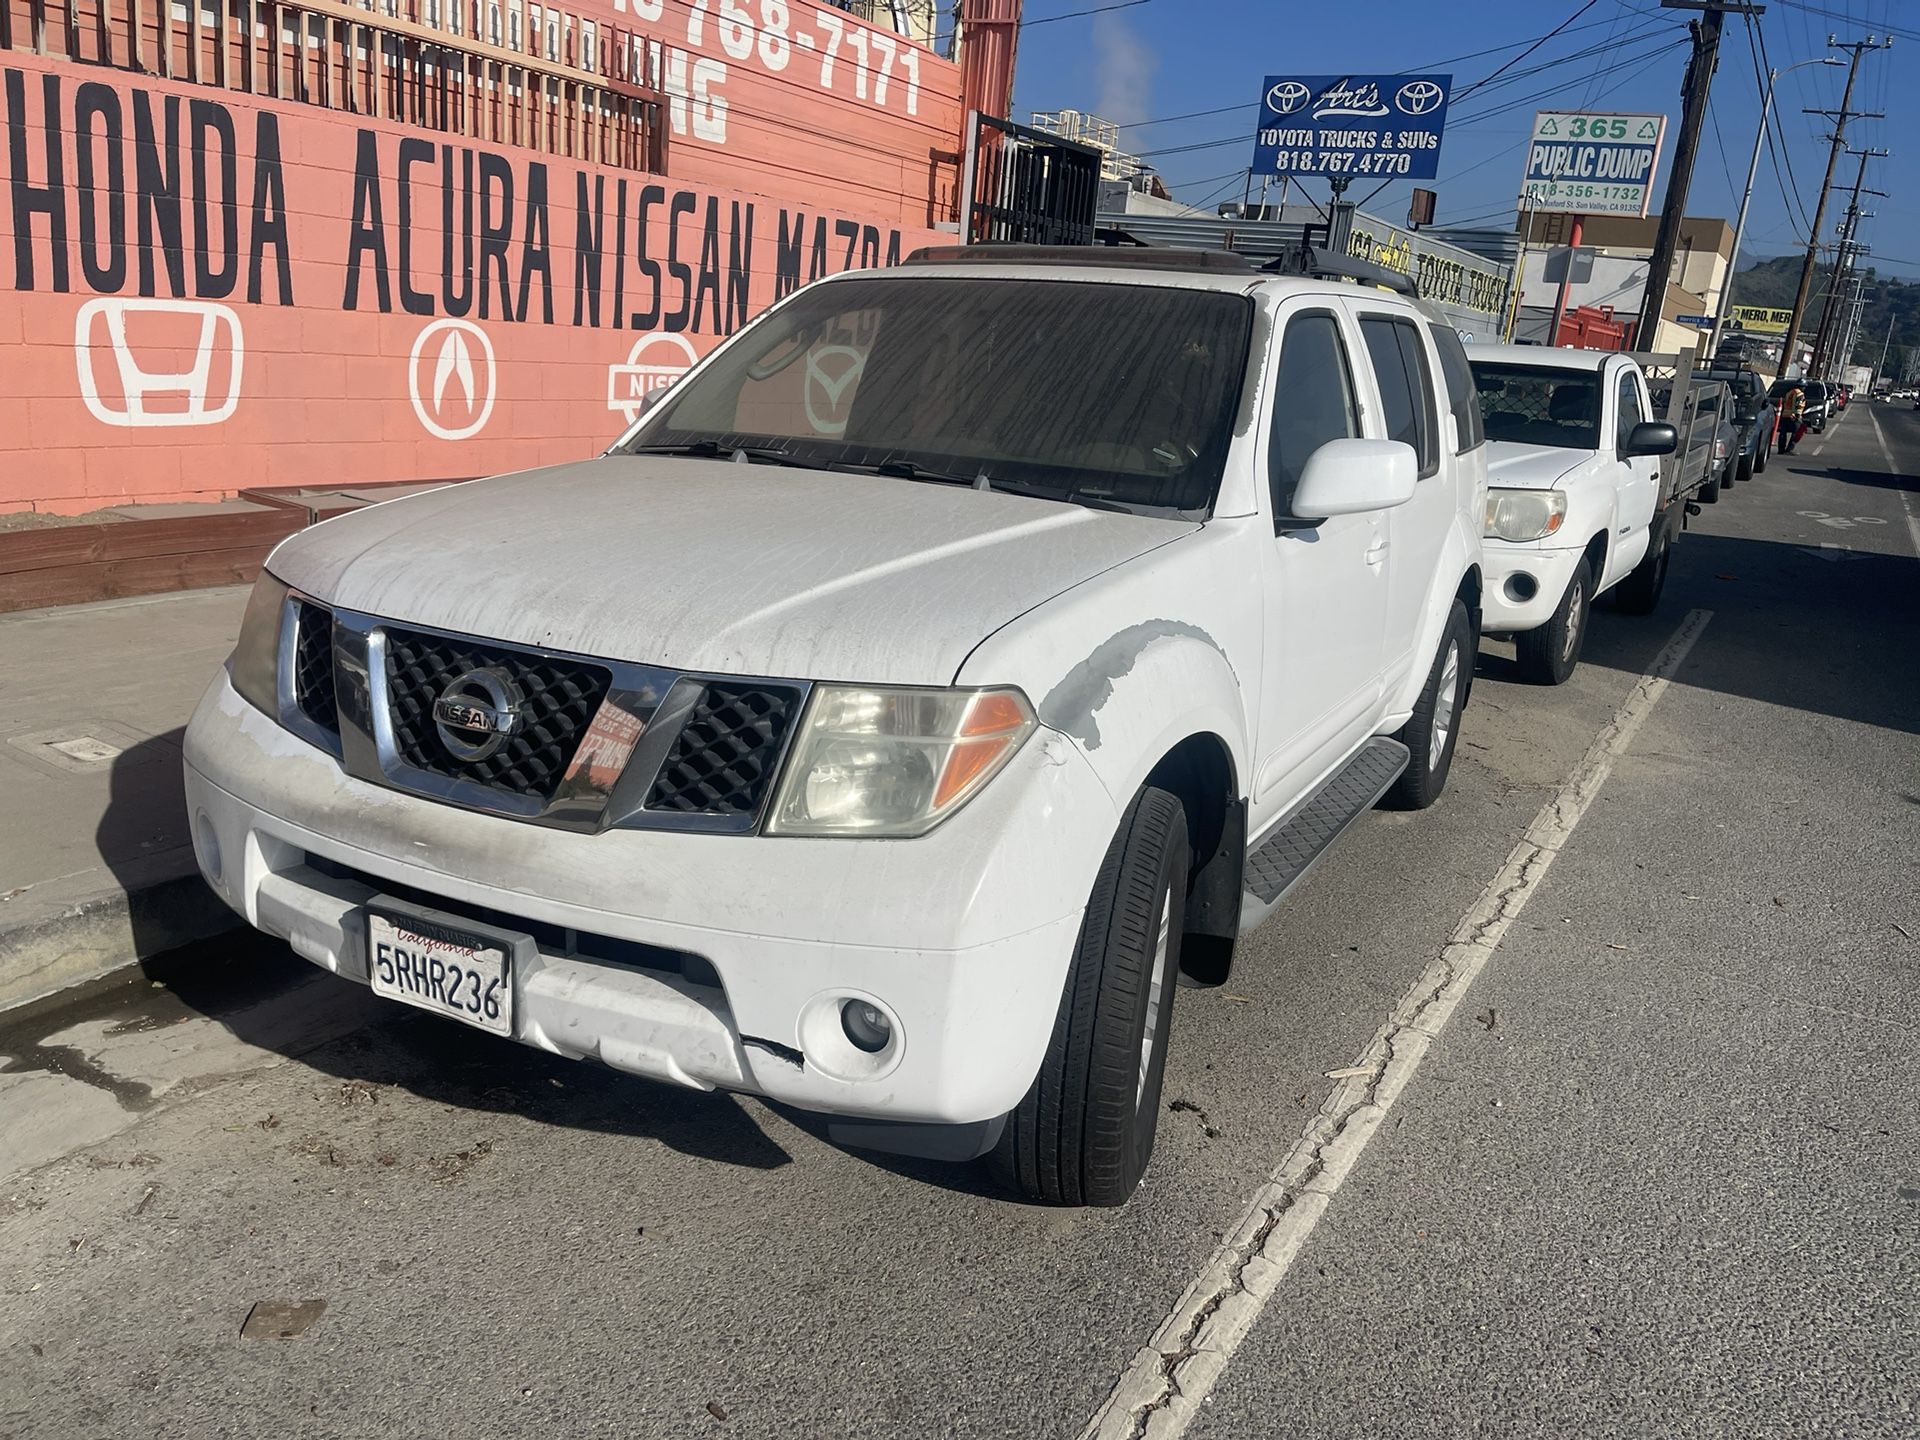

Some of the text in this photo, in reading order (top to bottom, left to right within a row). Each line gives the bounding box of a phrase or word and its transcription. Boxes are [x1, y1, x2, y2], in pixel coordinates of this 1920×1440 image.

[1312, 78, 1380, 109] Art's
[1259, 129, 1438, 149] TOYOTA TRUCKS & SUVs
[1569, 118, 1628, 139] 365
[1276, 150, 1411, 174] 818.767.4770
[1529, 145, 1653, 180] PUBLIC DUMP
[5, 68, 295, 308] HONDA
[343, 128, 555, 325] ACURA
[574, 170, 755, 336] NISSAN
[1531, 183, 1640, 201] 818-356-1732
[1609, 203, 1619, 212] CA
[1416, 252, 1465, 306] TOYOTA
[1740, 308, 1792, 324] MERO, MER
[629, 373, 680, 398] NIS
[435, 700, 498, 731] NISSAN
[376, 942, 501, 1020] 5RHR236
